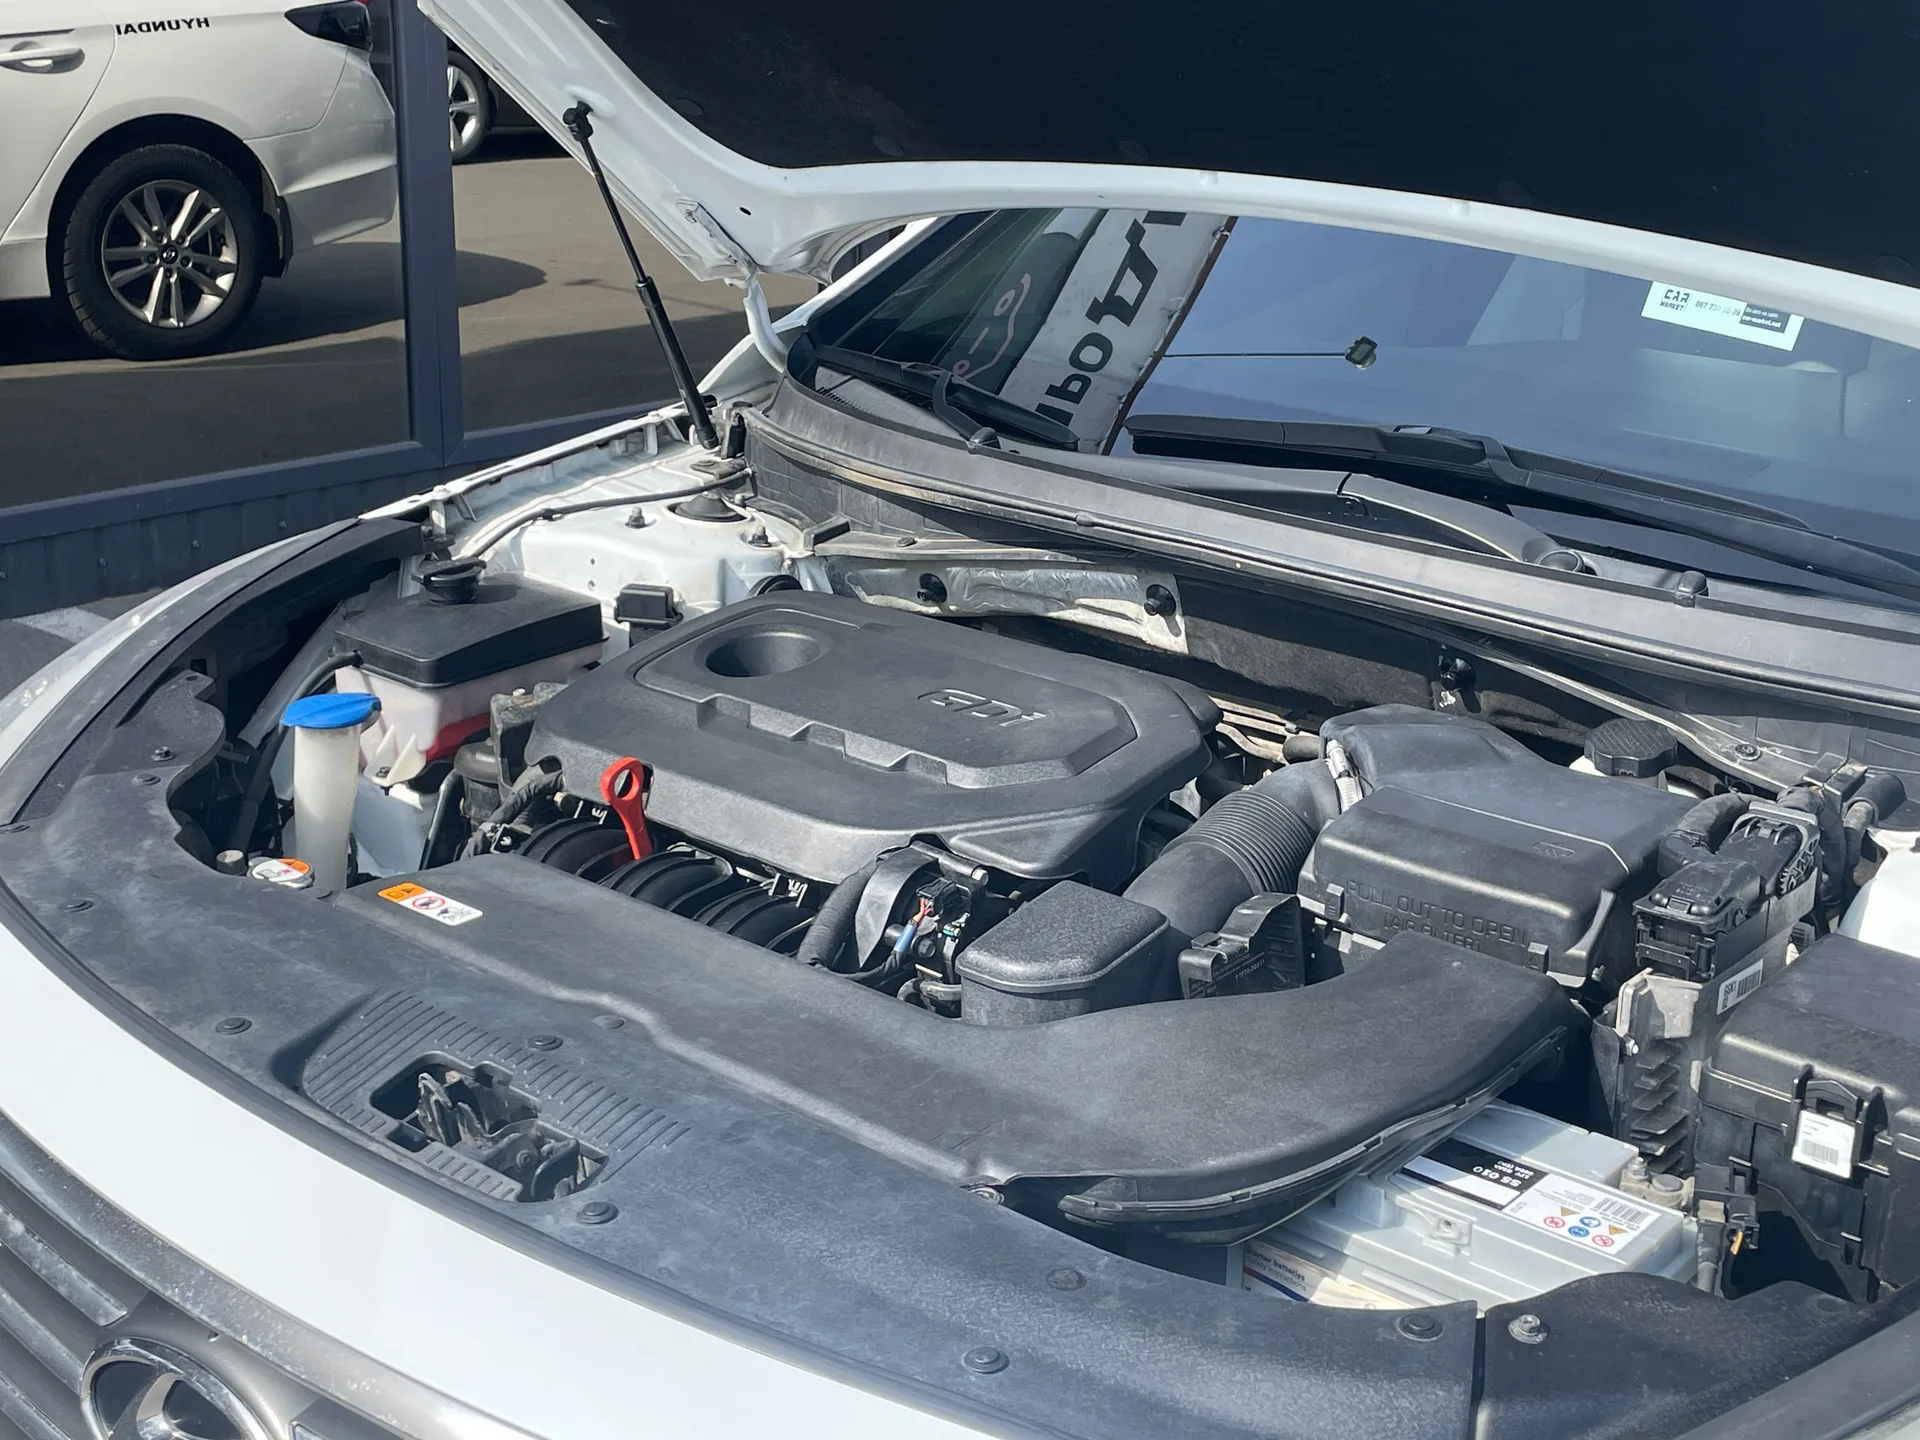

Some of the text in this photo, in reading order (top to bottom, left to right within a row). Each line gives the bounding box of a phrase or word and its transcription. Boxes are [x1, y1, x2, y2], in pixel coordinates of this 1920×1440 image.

[1664, 289, 1690, 303] CAR
[1346, 880, 1527, 947] PULL OUT TO OPEN
[1472, 1166, 1522, 1187] S5 010
[1273, 1259, 1305, 1281] batteries
